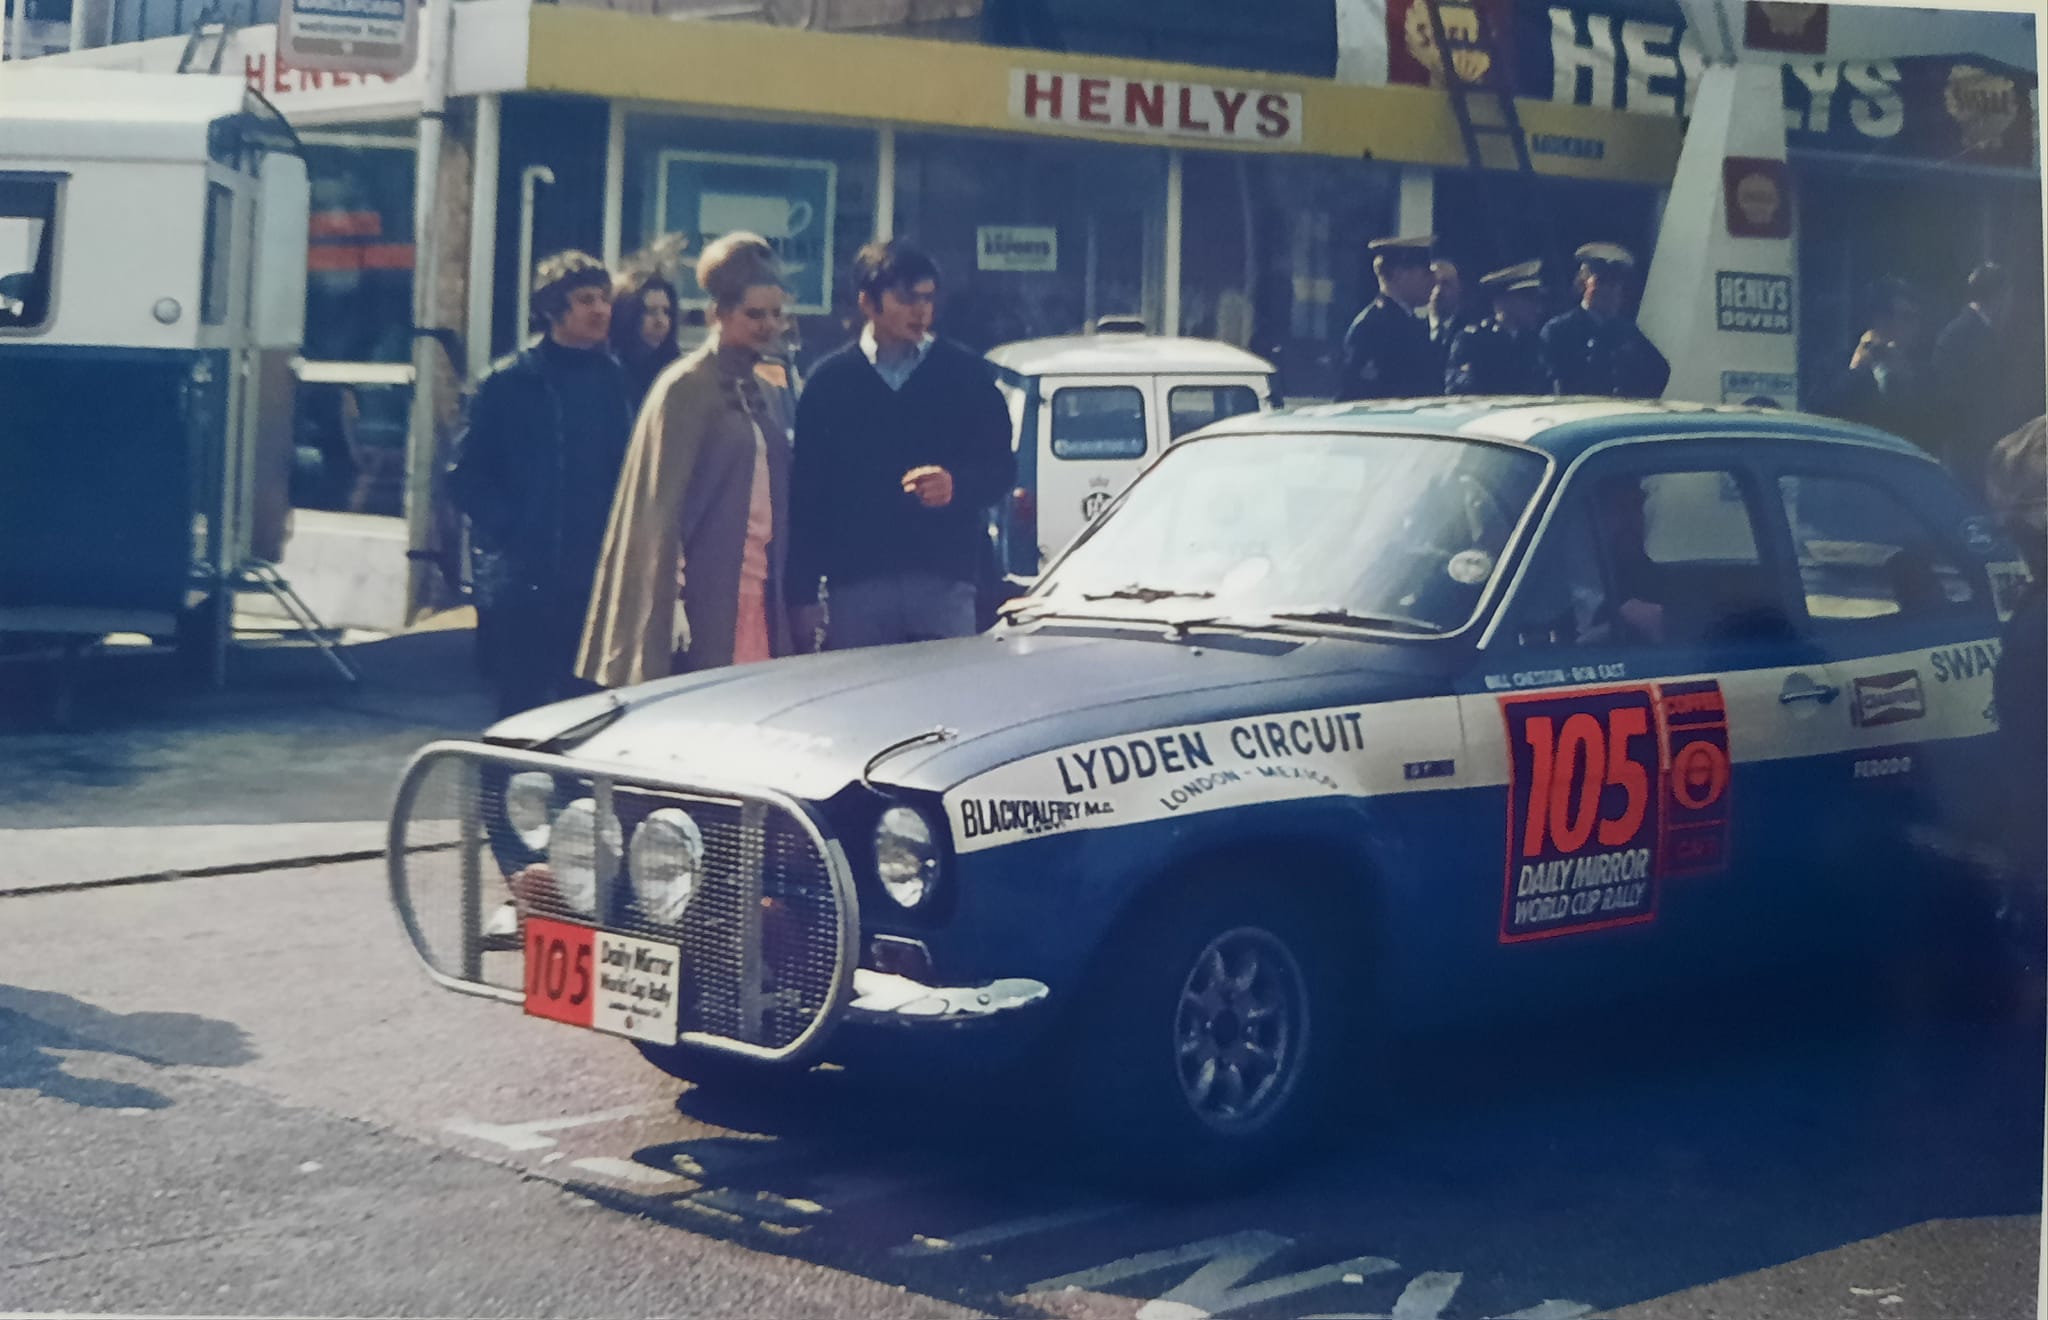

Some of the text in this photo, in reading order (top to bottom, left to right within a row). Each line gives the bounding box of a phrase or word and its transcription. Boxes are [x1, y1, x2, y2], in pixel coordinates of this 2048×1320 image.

[1025, 74, 1290, 138] HENLYS
[1720, 277, 1787, 311] HENLYS
[1057, 712, 1366, 795] LYDDEN CIRCUIT
[1160, 769, 1241, 811] LONDON
[1256, 765, 1338, 790] MEXICO
[1523, 706, 1649, 857] 105
[961, 799, 1080, 838] BLACKPALFREY
[1517, 848, 1650, 897] DAILY MIRROR
[1515, 883, 1647, 925] WORLD CUP RALLY
[532, 935, 593, 1006] 105
[601, 940, 674, 976] Daily Mirror
[601, 973, 628, 994] World
